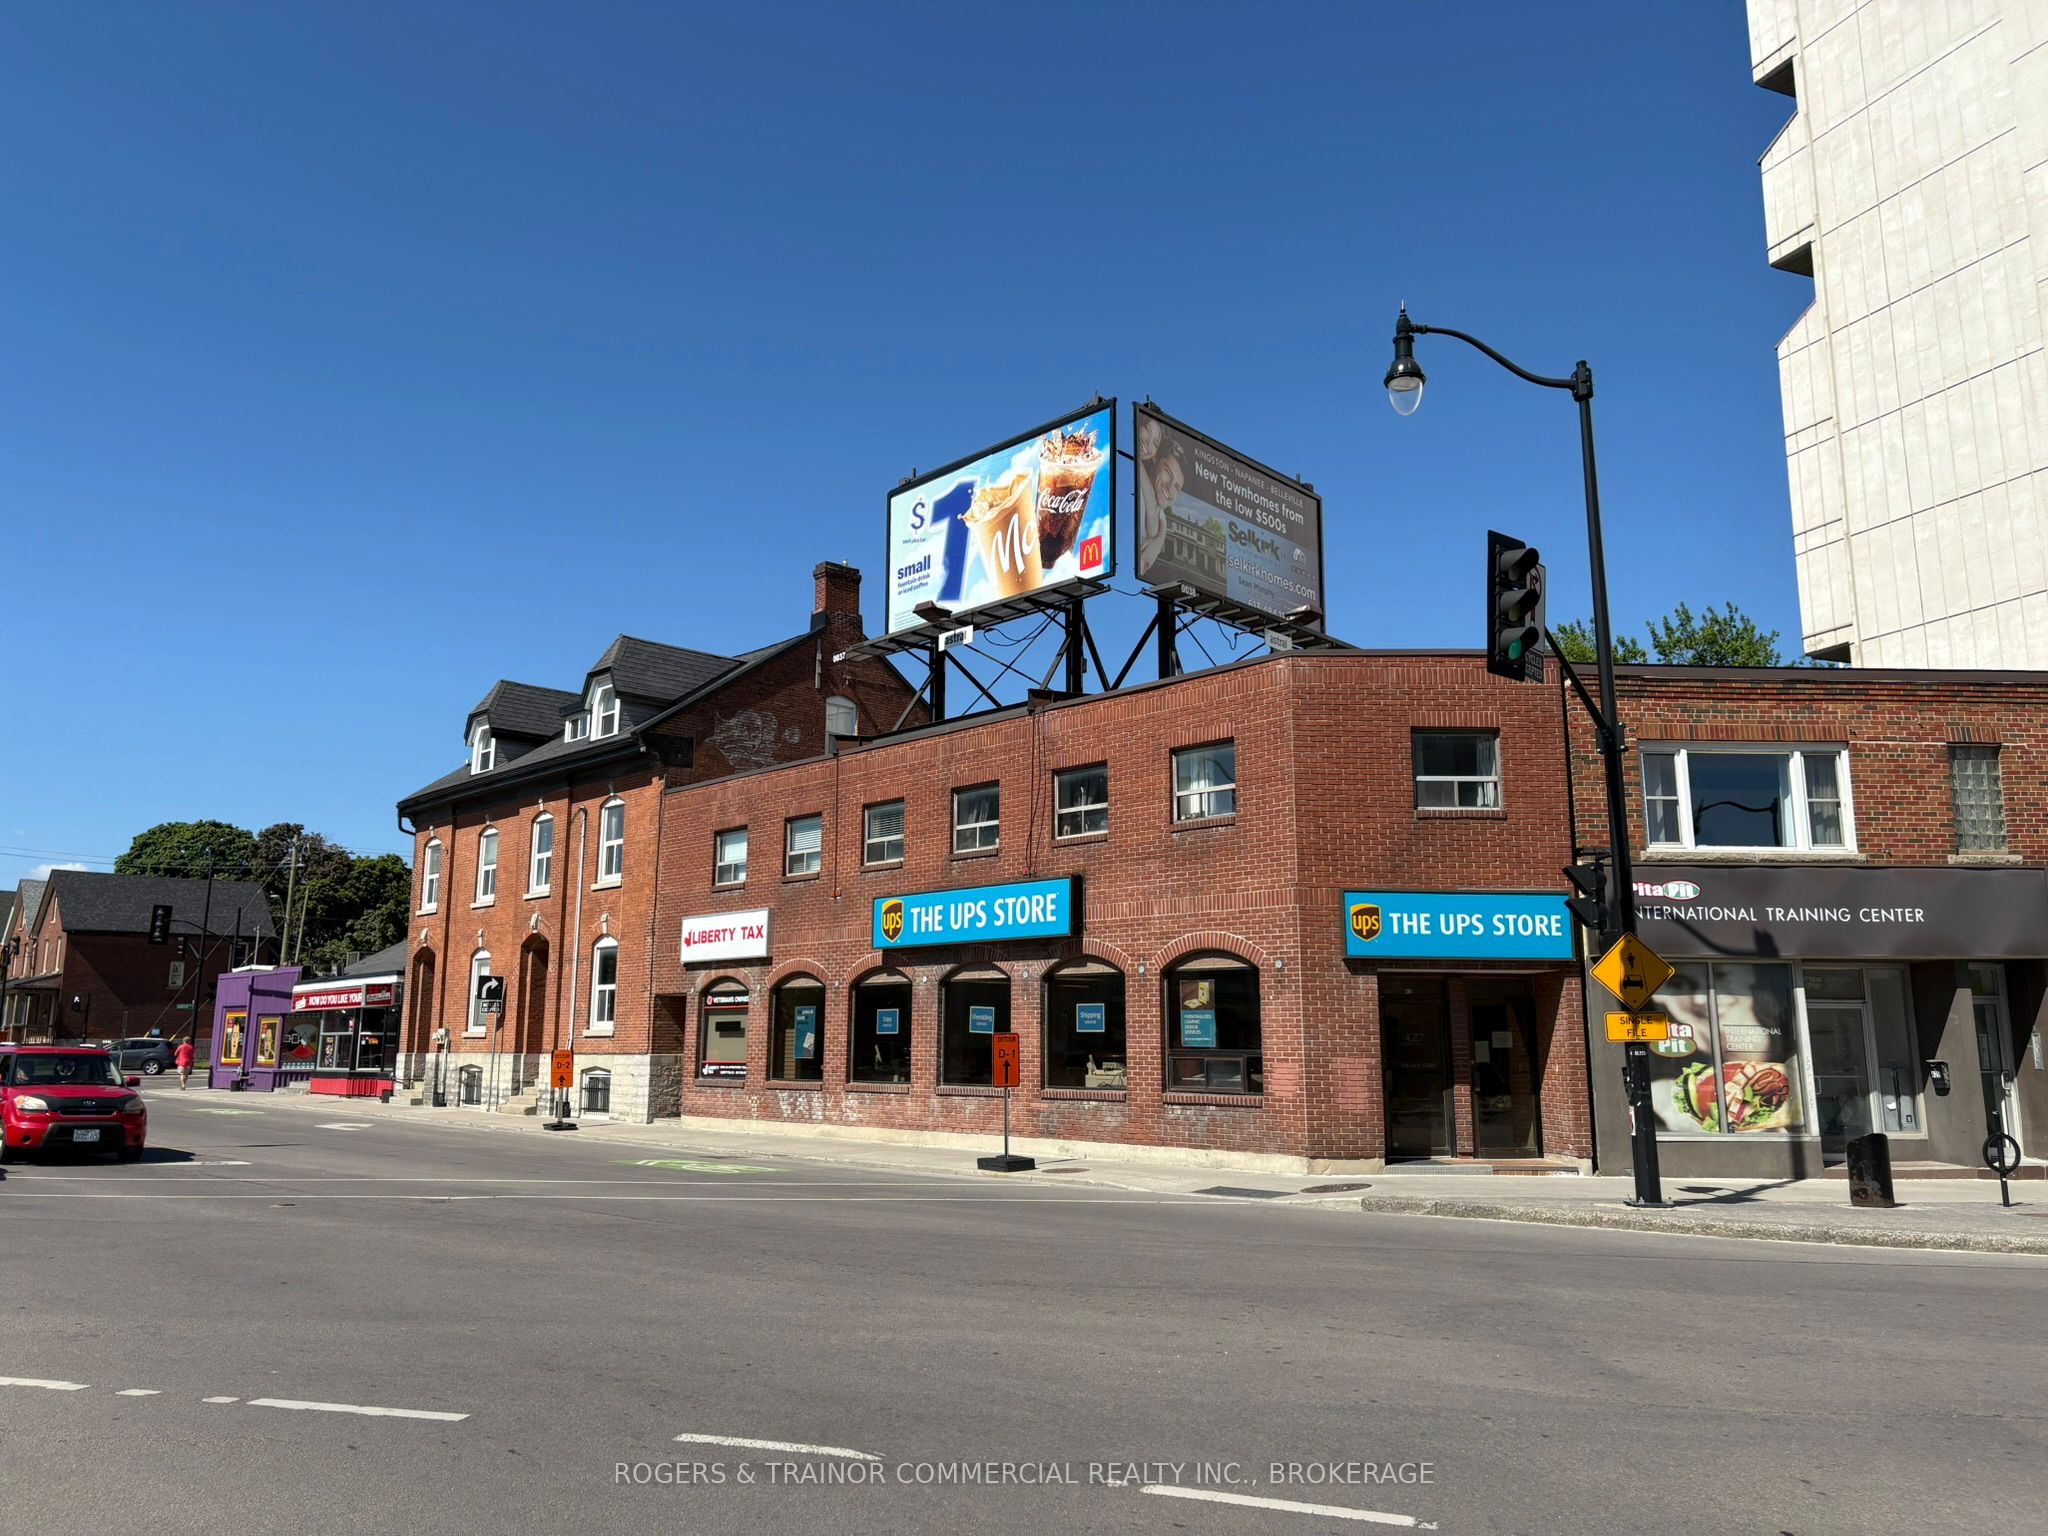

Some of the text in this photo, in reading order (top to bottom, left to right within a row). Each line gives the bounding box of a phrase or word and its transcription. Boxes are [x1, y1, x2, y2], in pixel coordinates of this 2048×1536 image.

[1194, 447, 1230, 473] KINGSTON
[1235, 467, 1265, 490] NAPANEE
[1270, 486, 1304, 509] BELLEVILLE
[1195, 461, 1304, 526] New Townhomes from
[1215, 489, 1288, 535] the low $500s
[1228, 521, 1280, 561] Selkirk
[897, 554, 931, 580] small
[898, 573, 930, 588] fountain drink
[903, 585, 913, 594] iced
[913, 581, 929, 591] coffee
[1228, 556, 1317, 601] selkirkhomes.com
[944, 629, 967, 647] astral
[1667, 881, 1695, 899] Pit
[883, 893, 1057, 936] ups THE UPS STORE
[1634, 905, 1925, 923] NTERNATIONAL TRAINING CENTER
[1352, 912, 1563, 937] ups THE UPS STORE
[692, 924, 764, 945] LIBERTY TAX
[309, 996, 320, 1006] HOW
[320, 995, 328, 1005] DO
[328, 994, 337, 1005] YOU
[338, 993, 349, 1004] LIKE
[1080, 1011, 1101, 1020] Shipping
[1619, 1016, 1653, 1025] SINGLE
[1627, 1028, 1648, 1037] FILE
[1727, 1027, 1781, 1036] INTERNATIONAL
[998, 1049, 1016, 1060] D-1
[1658, 1038, 1689, 1053] Pit
[1727, 1043, 1754, 1051] CENTER
[556, 1061, 570, 1070] D-2
